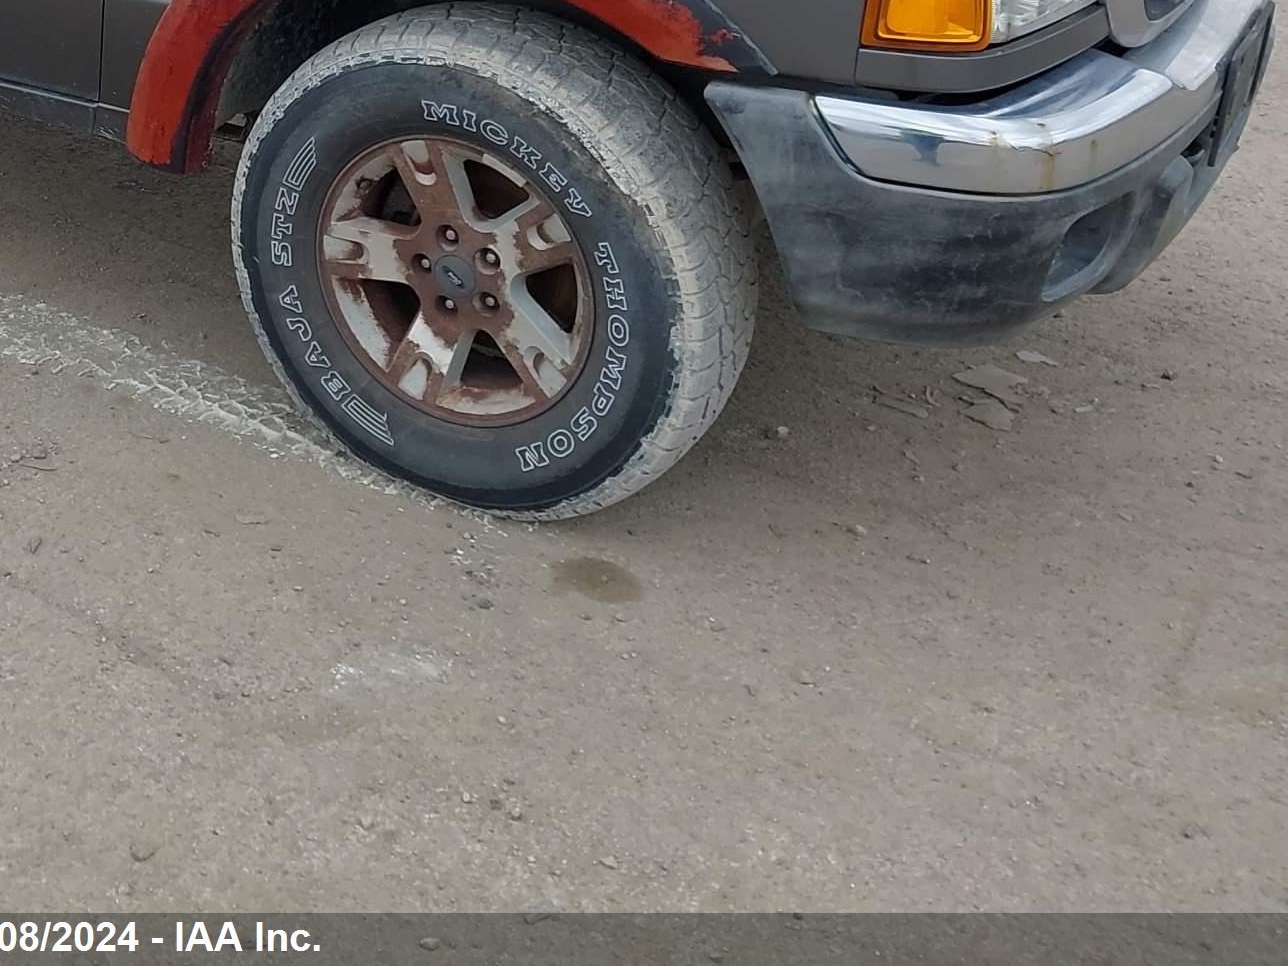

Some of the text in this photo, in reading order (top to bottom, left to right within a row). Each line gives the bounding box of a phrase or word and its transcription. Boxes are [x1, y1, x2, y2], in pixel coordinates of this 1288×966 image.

[279, 285, 352, 402] BAJA
[421, 99, 630, 473] MICKEY THOMPSON
